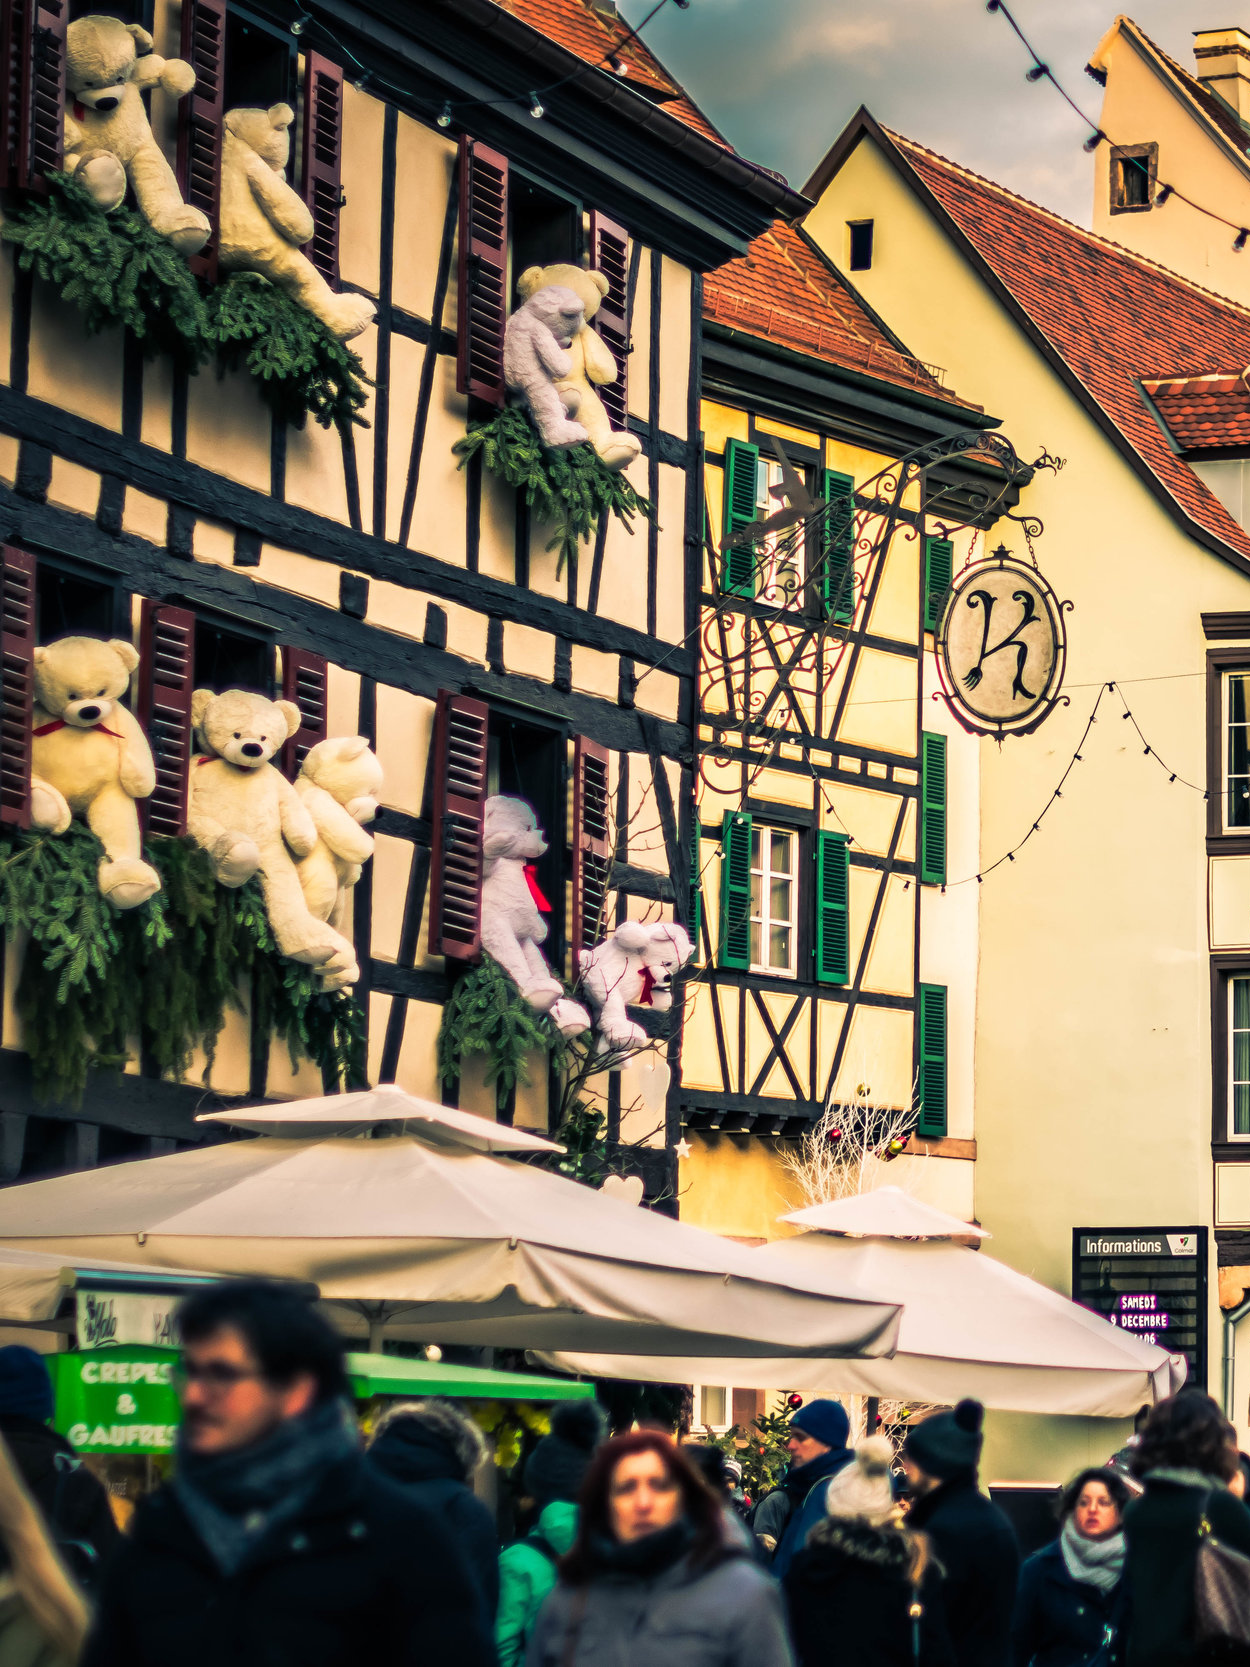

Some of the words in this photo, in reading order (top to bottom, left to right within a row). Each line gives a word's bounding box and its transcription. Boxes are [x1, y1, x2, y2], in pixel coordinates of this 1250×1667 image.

[962, 590, 1041, 701] K
[1086, 1238, 1162, 1253] Informations
[1121, 1295, 1156, 1309] SAMEDI
[1121, 1314, 1168, 1327] DECEMBRE
[80, 1361, 172, 1384] CREPES
[116, 1393, 137, 1415] &
[68, 1422, 178, 1447] GAUFRES
